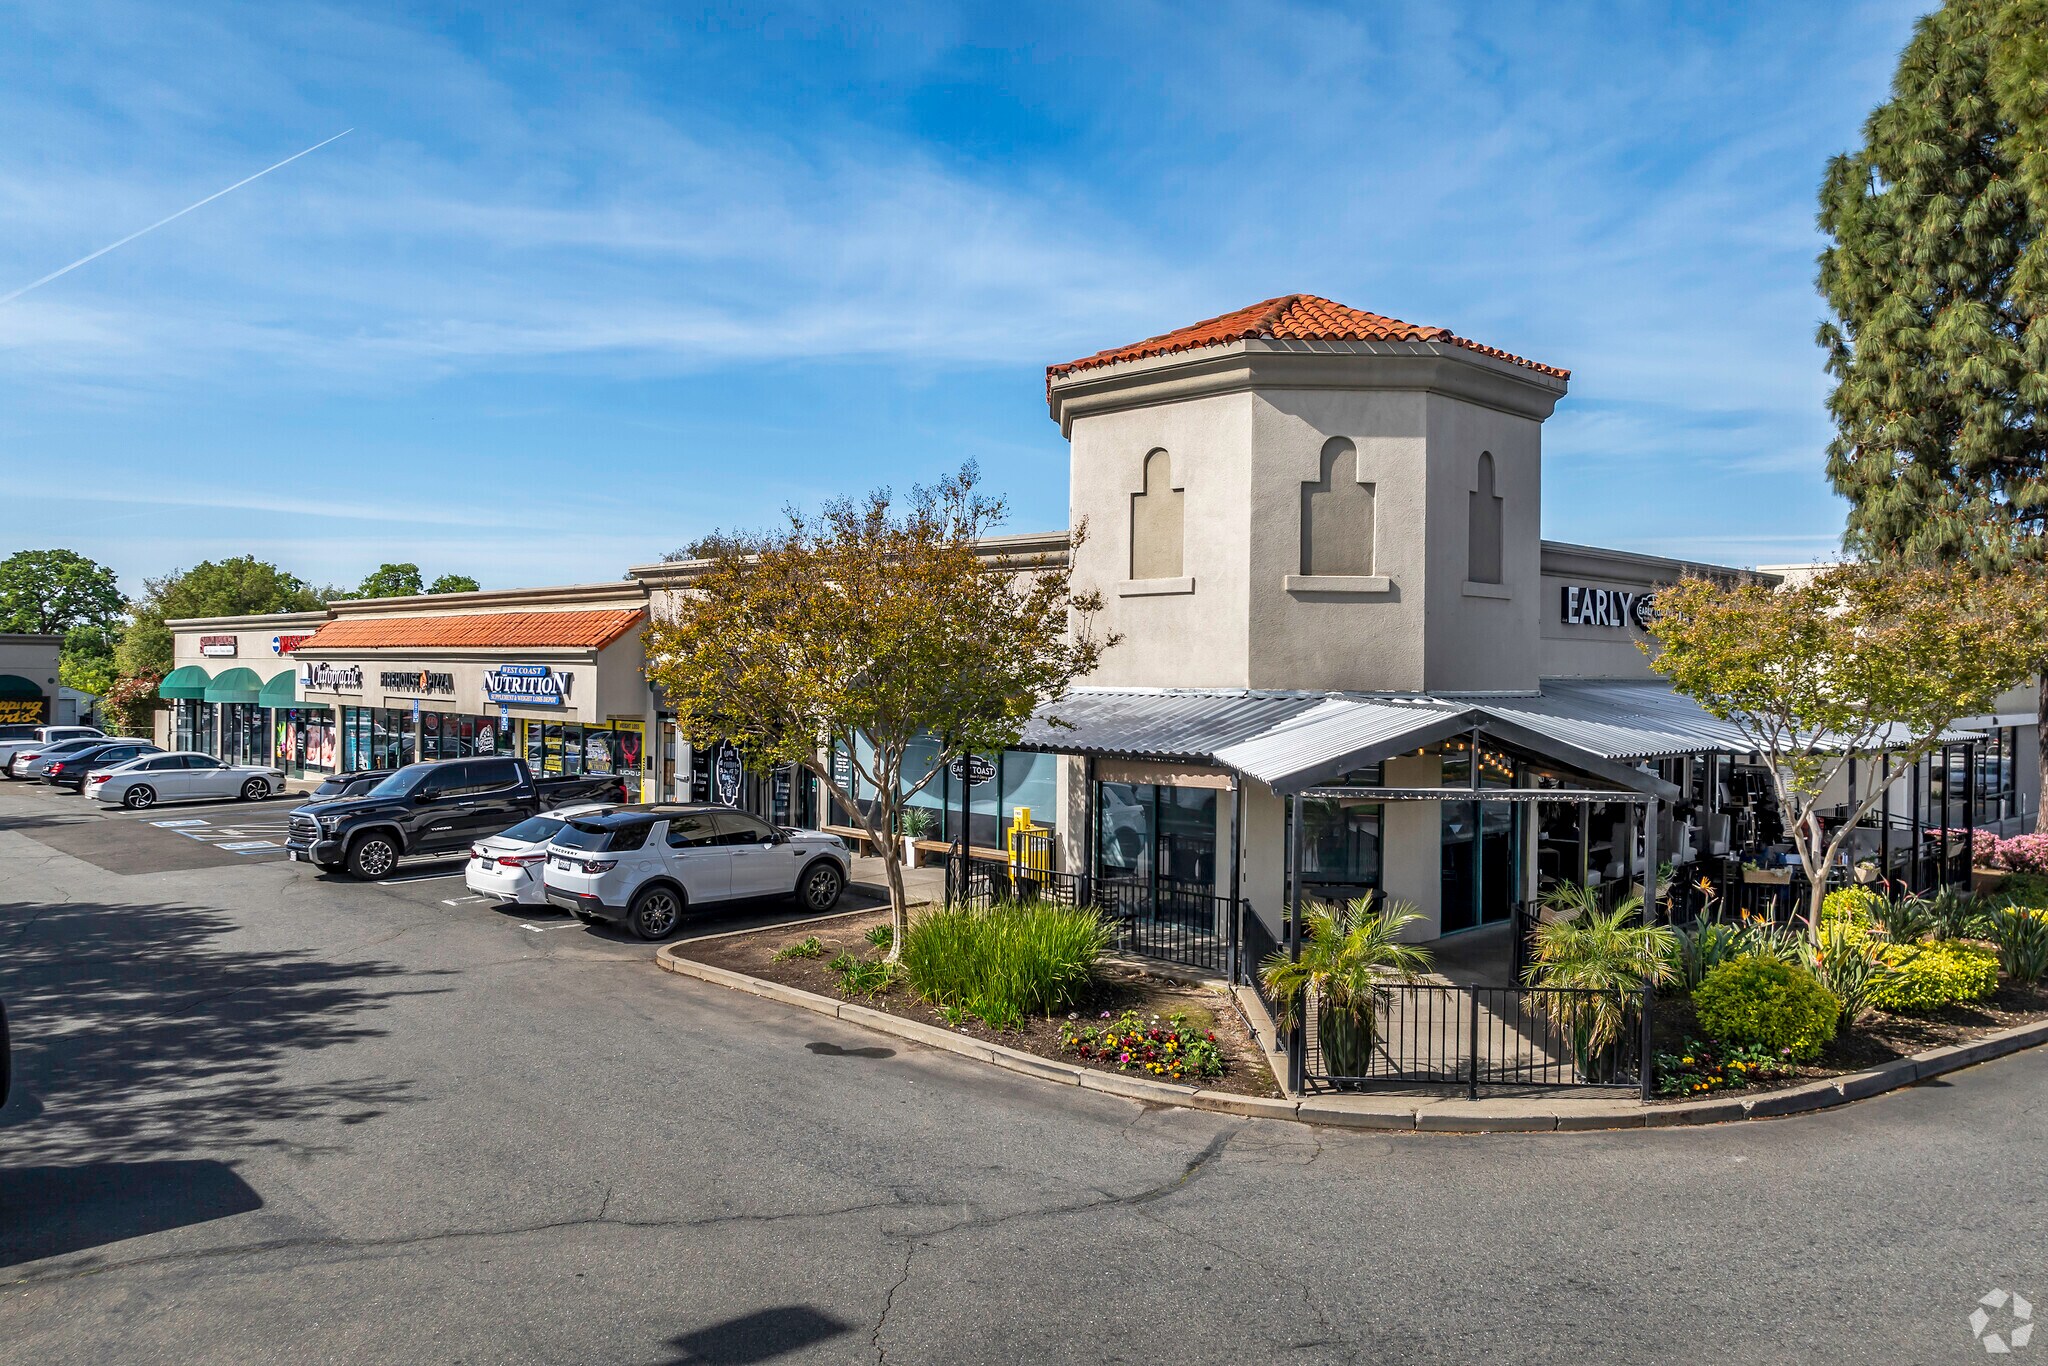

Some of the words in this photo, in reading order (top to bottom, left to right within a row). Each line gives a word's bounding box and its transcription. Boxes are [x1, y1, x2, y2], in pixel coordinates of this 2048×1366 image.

[1568, 586, 1633, 627] EARLY
[312, 662, 358, 689] Chiropractic
[502, 666, 518, 674] WEST
[518, 667, 542, 675] COAST
[381, 672, 420, 688] FIREHOUSE
[428, 673, 449, 689] PIZZA
[482, 671, 568, 695] NUTRITION
[972, 766, 994, 776] TOAST
[551, 847, 578, 856] DISCOVERY
